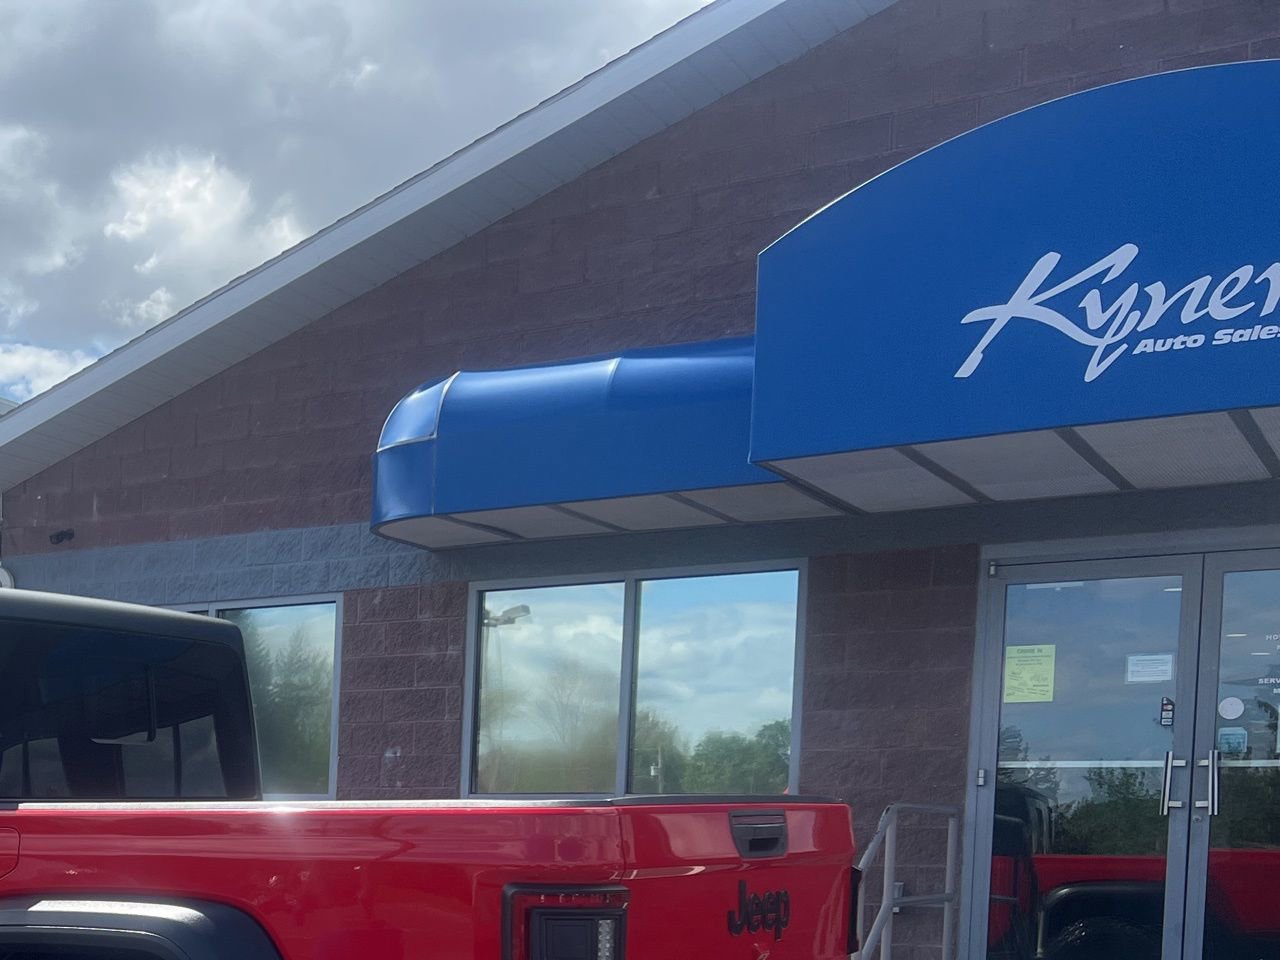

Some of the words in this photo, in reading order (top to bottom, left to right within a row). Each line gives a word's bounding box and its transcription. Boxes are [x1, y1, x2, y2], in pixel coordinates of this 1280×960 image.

[1132, 334, 1206, 355] Auto
[1212, 324, 1280, 345] Sale
[727, 879, 790, 942] Jeep
